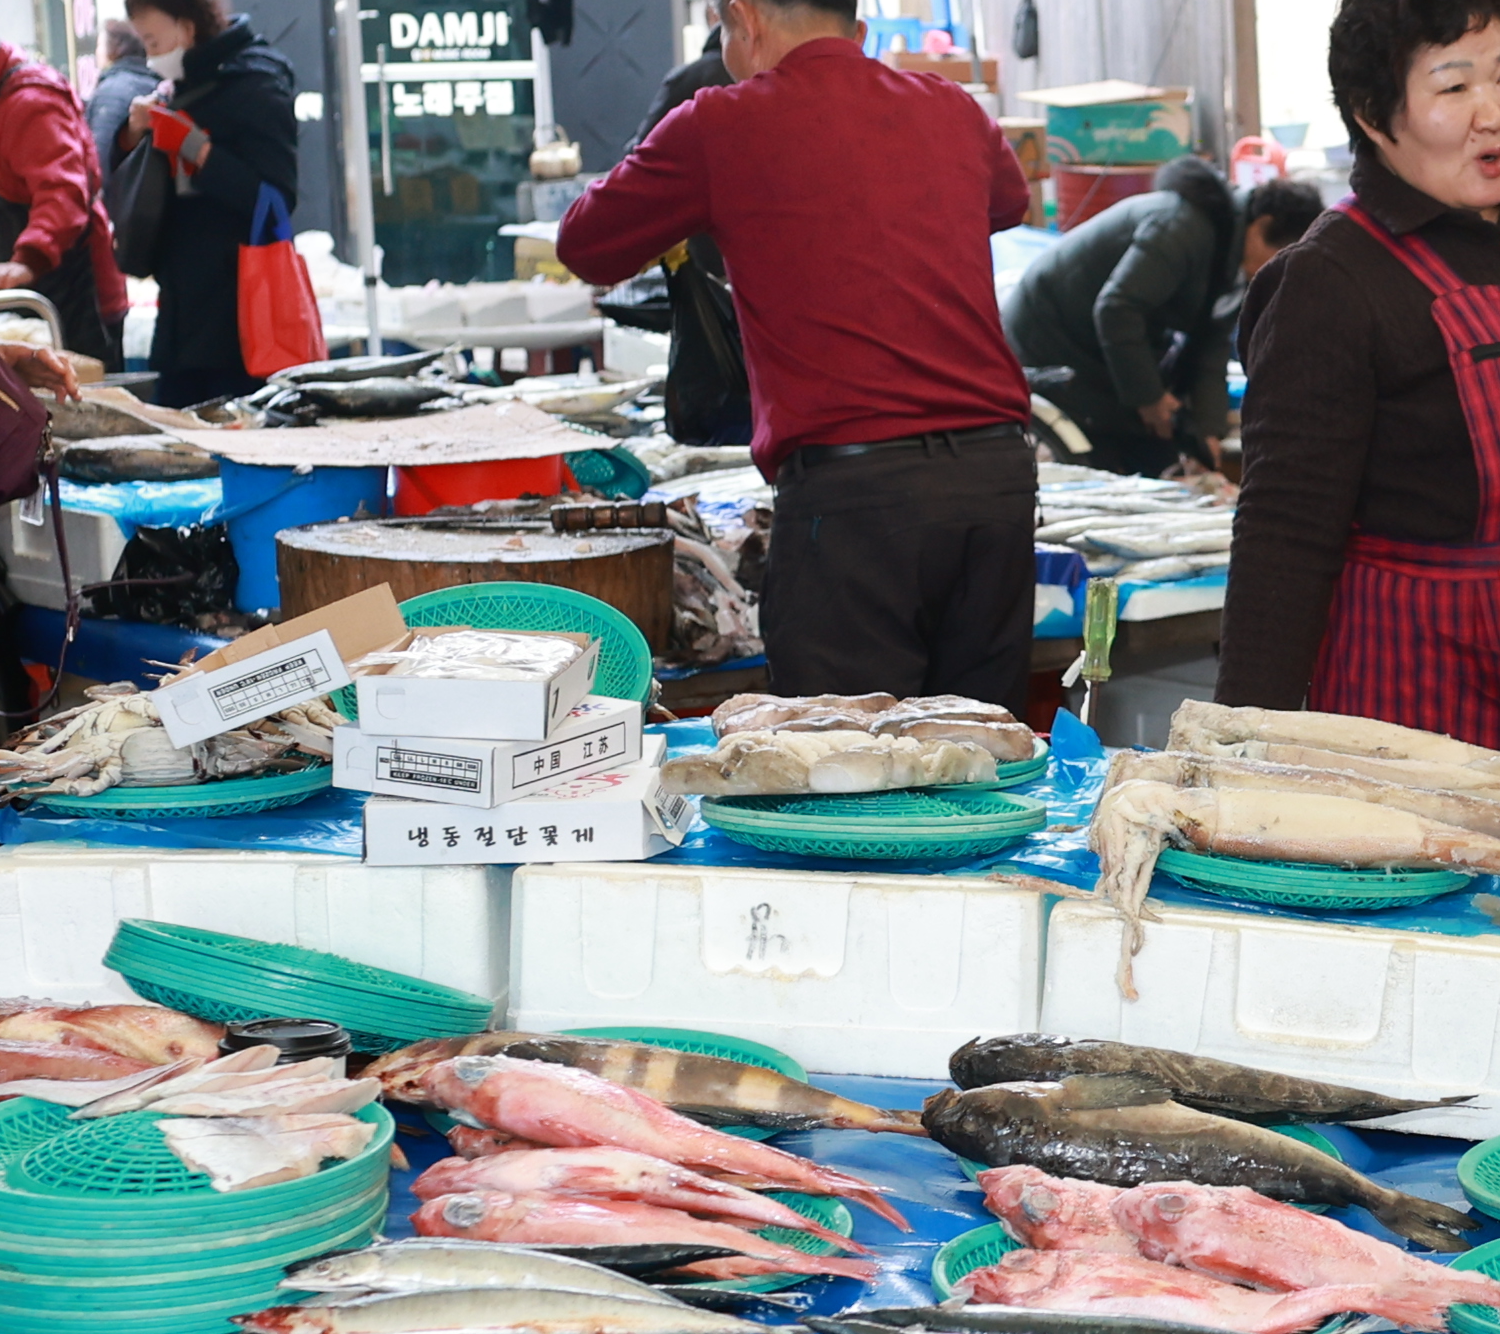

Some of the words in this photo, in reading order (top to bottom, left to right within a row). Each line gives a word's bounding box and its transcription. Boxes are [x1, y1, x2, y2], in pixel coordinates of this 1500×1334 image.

[388, 10, 510, 49] DAMJI
[533, 748, 562, 776] 中国
[582, 734, 609, 760] 江苏
